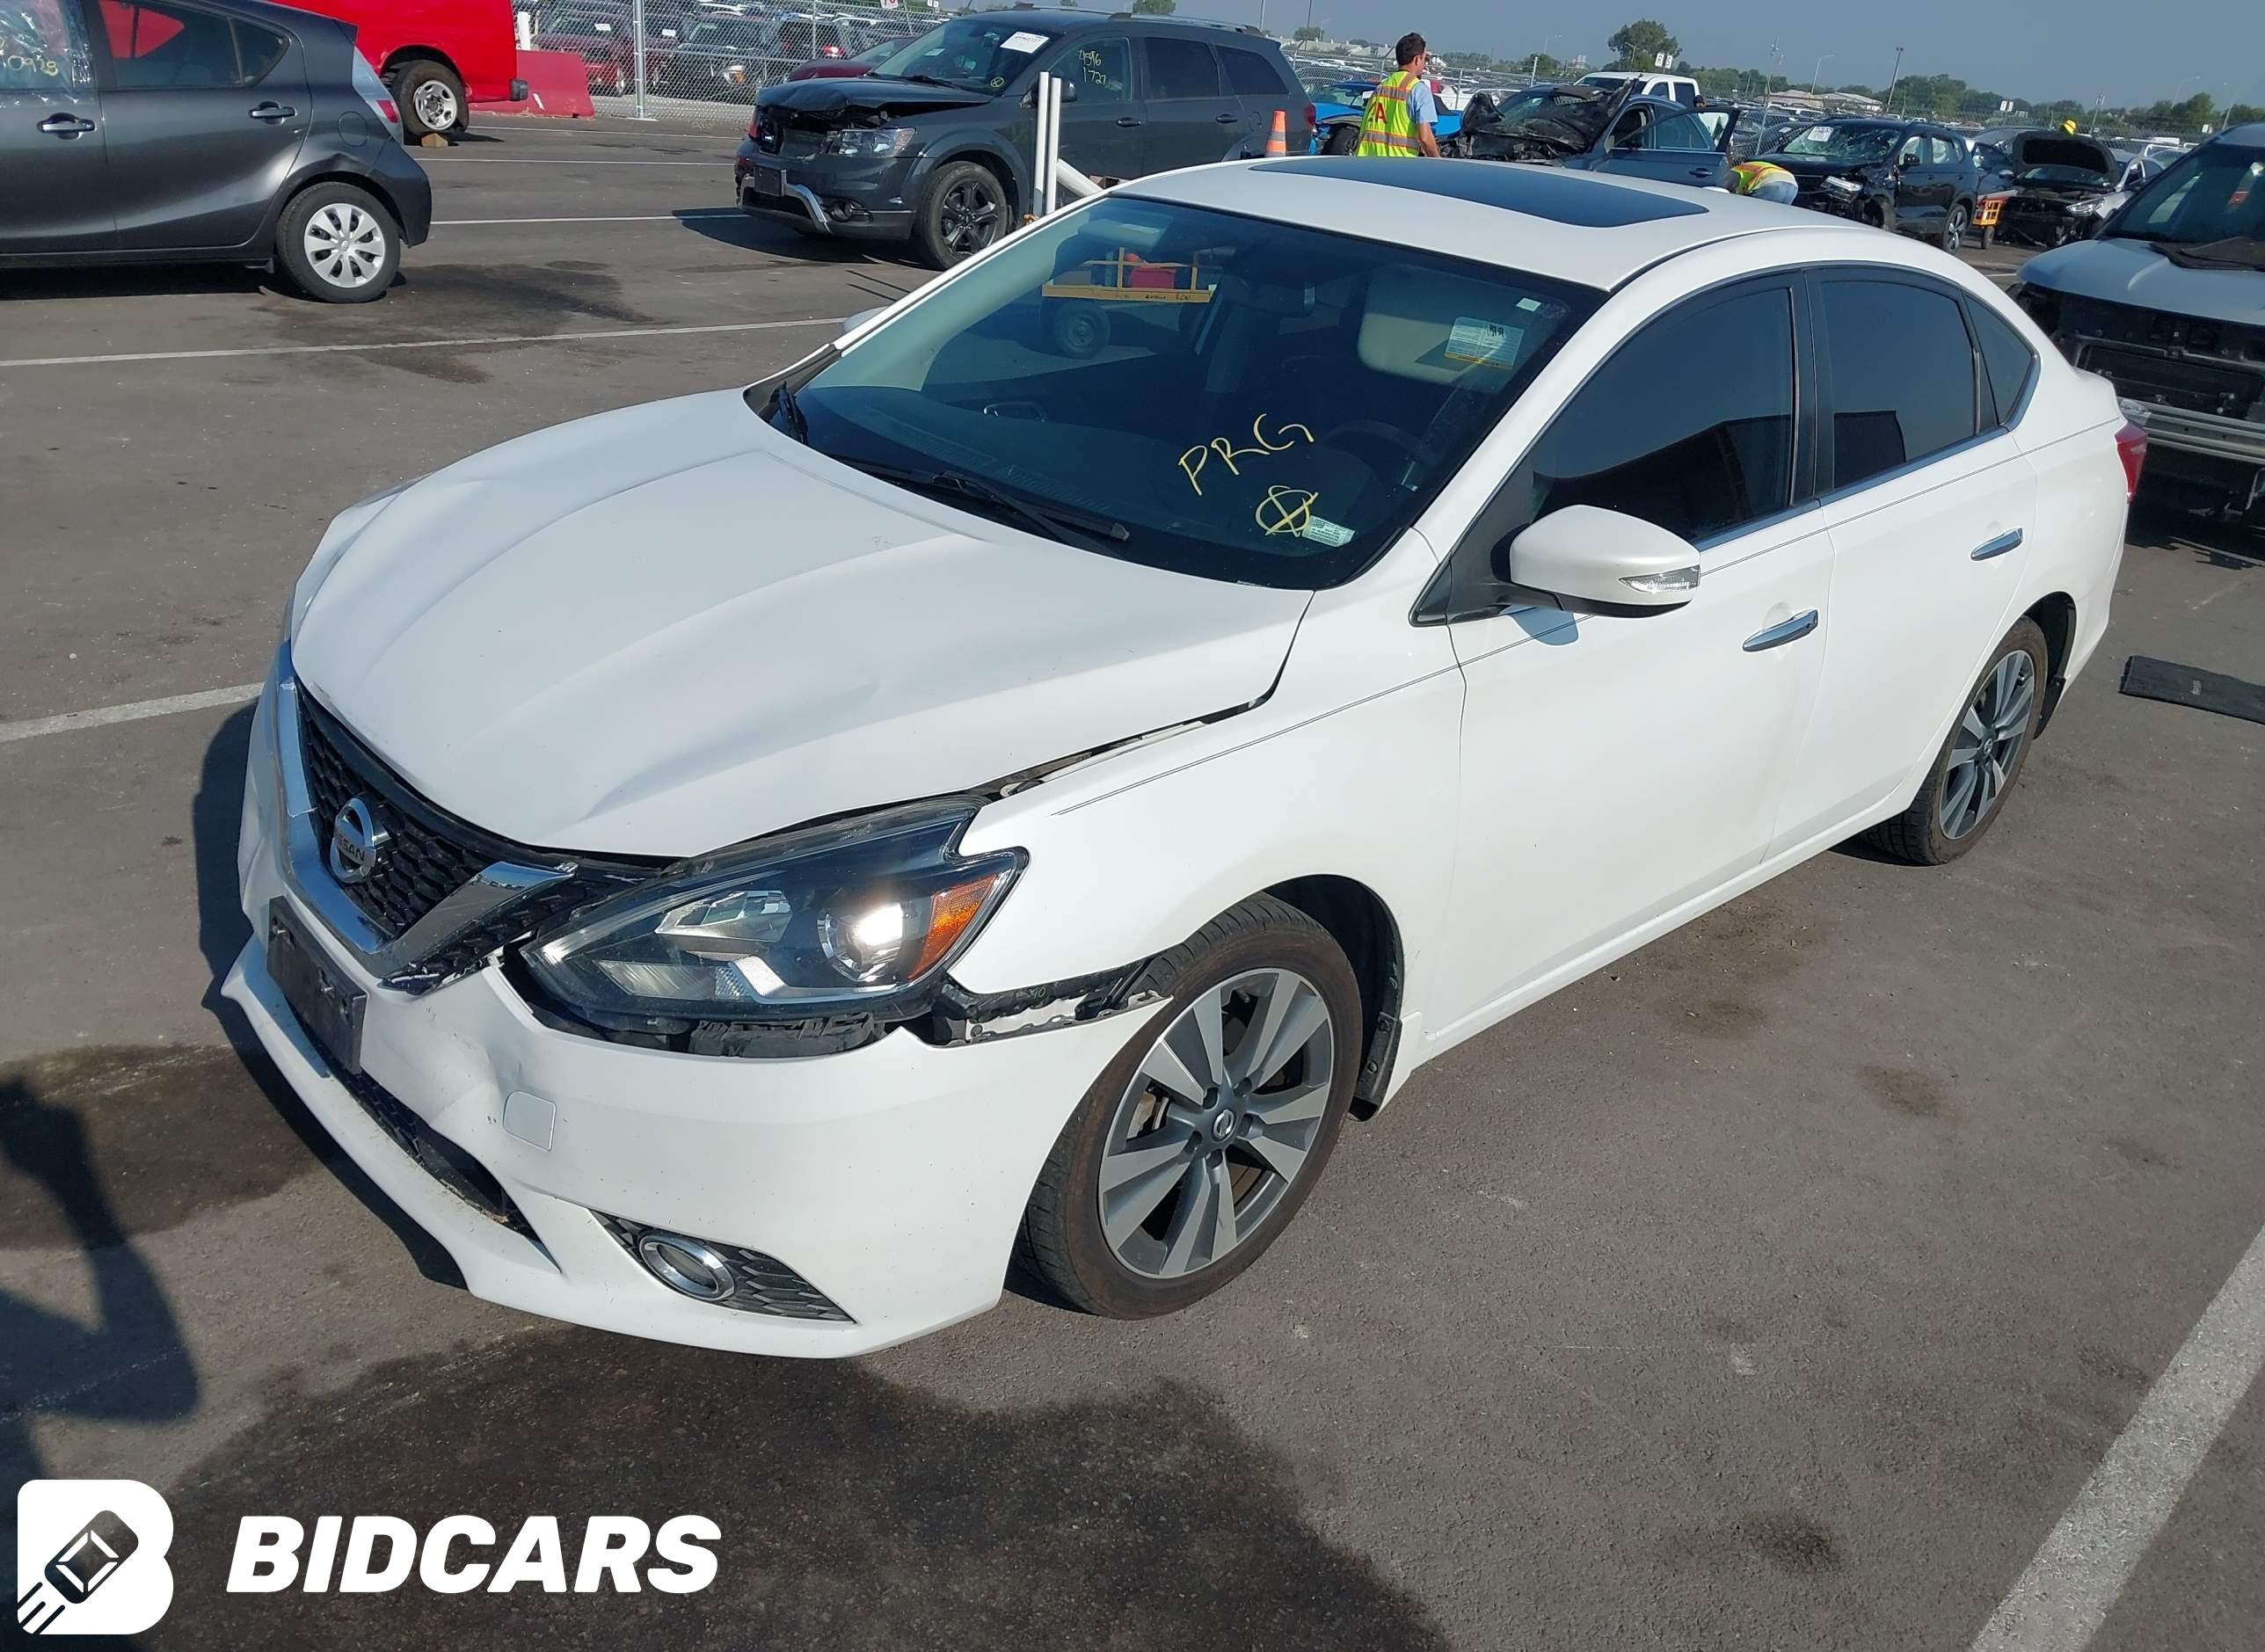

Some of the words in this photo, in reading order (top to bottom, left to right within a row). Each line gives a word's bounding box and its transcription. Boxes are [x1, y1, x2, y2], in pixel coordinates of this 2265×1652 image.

[1079, 49, 1102, 68] 4596
[1083, 66, 1107, 85] 1727
[1177, 412, 1315, 497] PRG
[336, 833, 366, 861] SSAN
